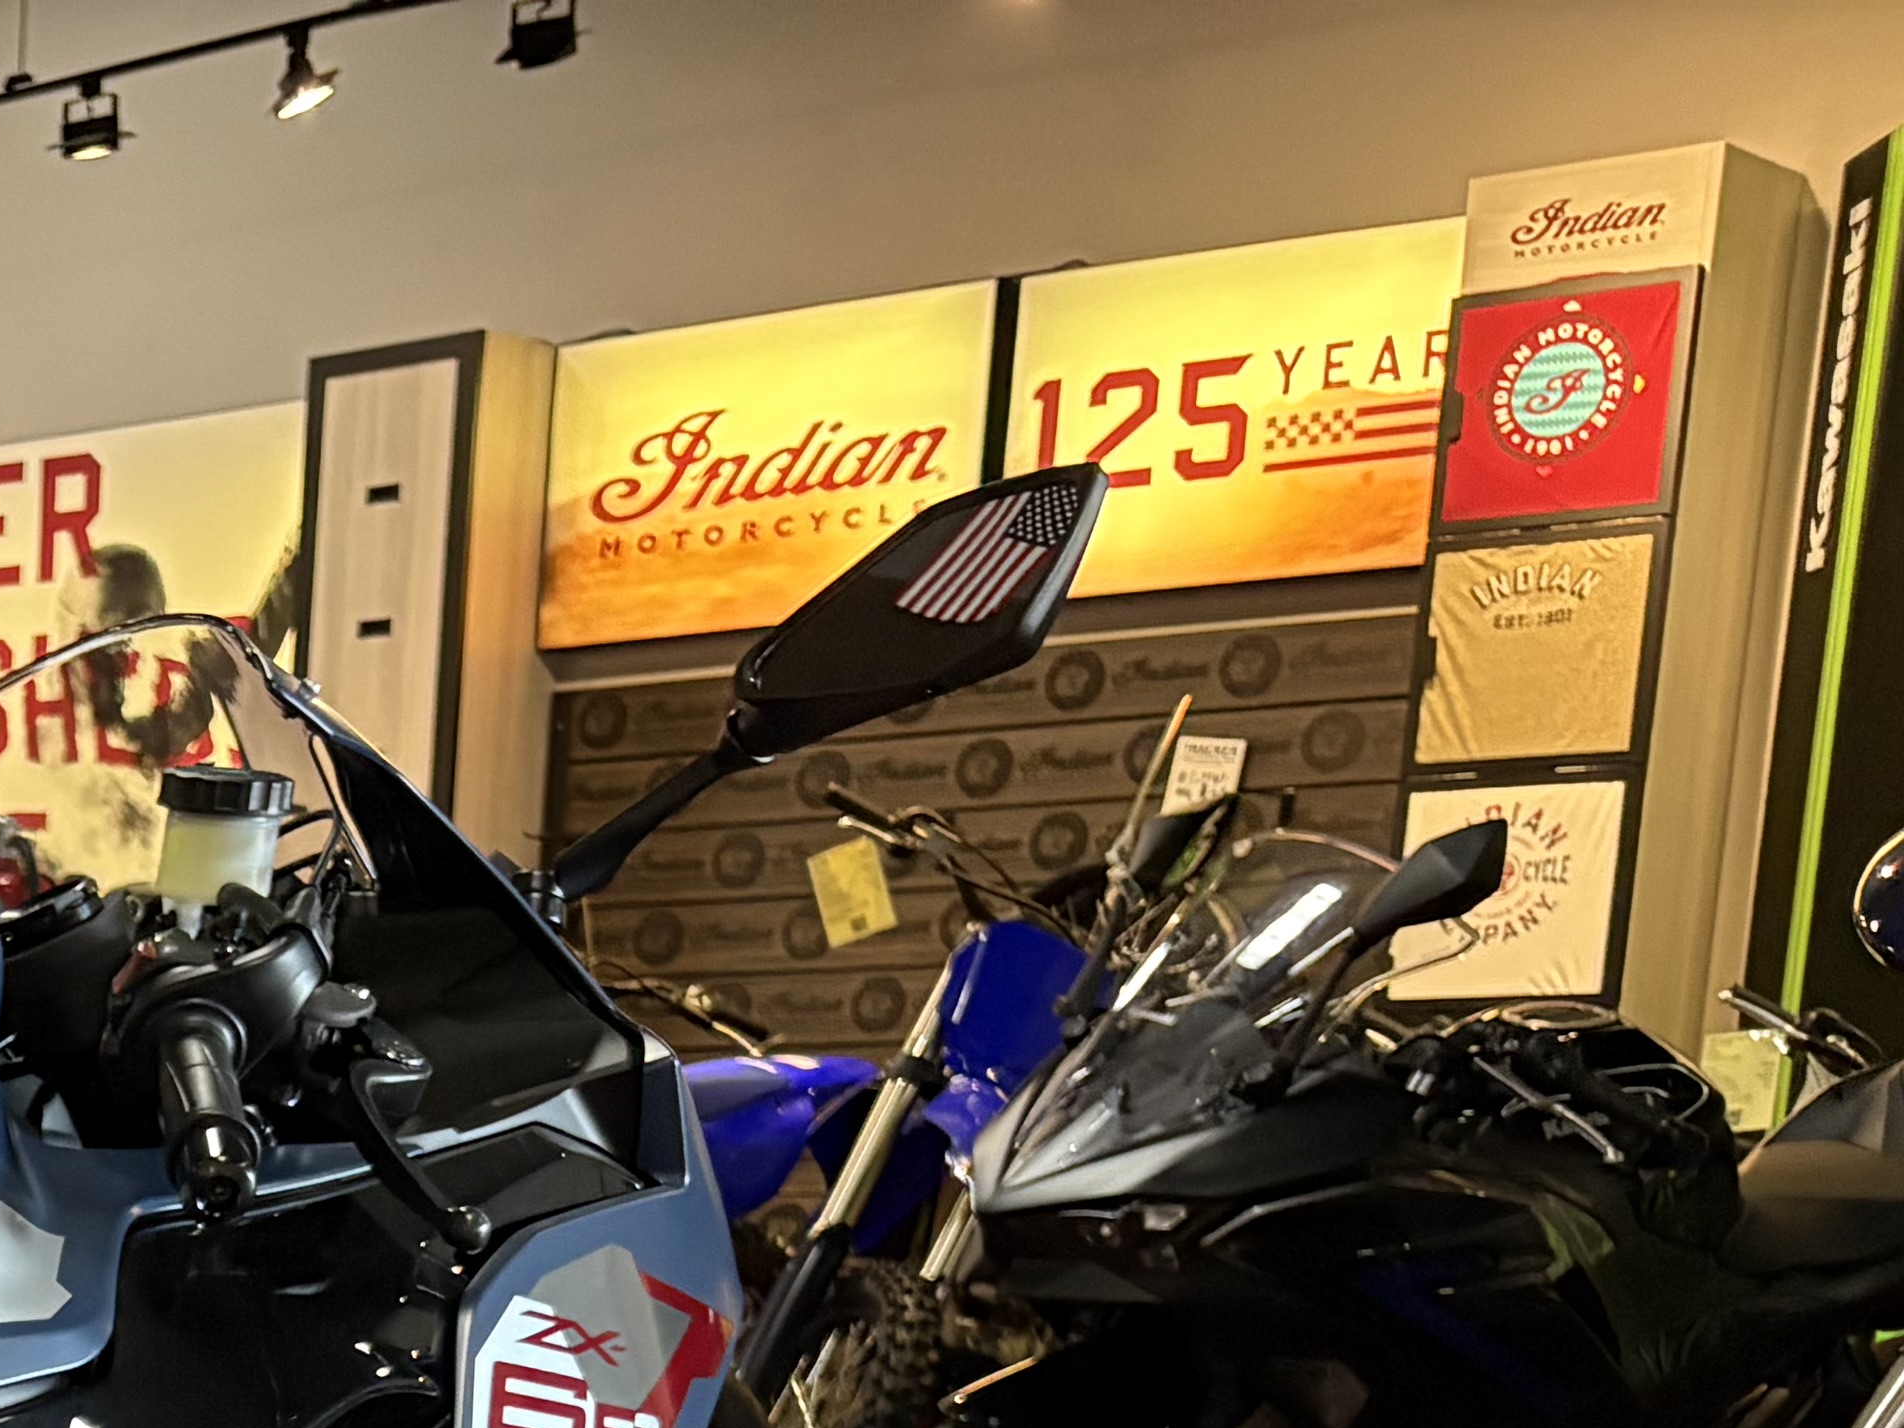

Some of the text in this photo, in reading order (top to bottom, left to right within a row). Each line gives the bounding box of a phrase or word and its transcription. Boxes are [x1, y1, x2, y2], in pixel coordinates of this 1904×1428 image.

[1511, 198, 1666, 246] Indian
[1514, 230, 1658, 258] MOTORCYCLE
[1034, 353, 1253, 488] 125
[1805, 197, 1874, 573] Kawasaki
[589, 408, 948, 523] Indian
[1469, 562, 1602, 610] INDIAN
